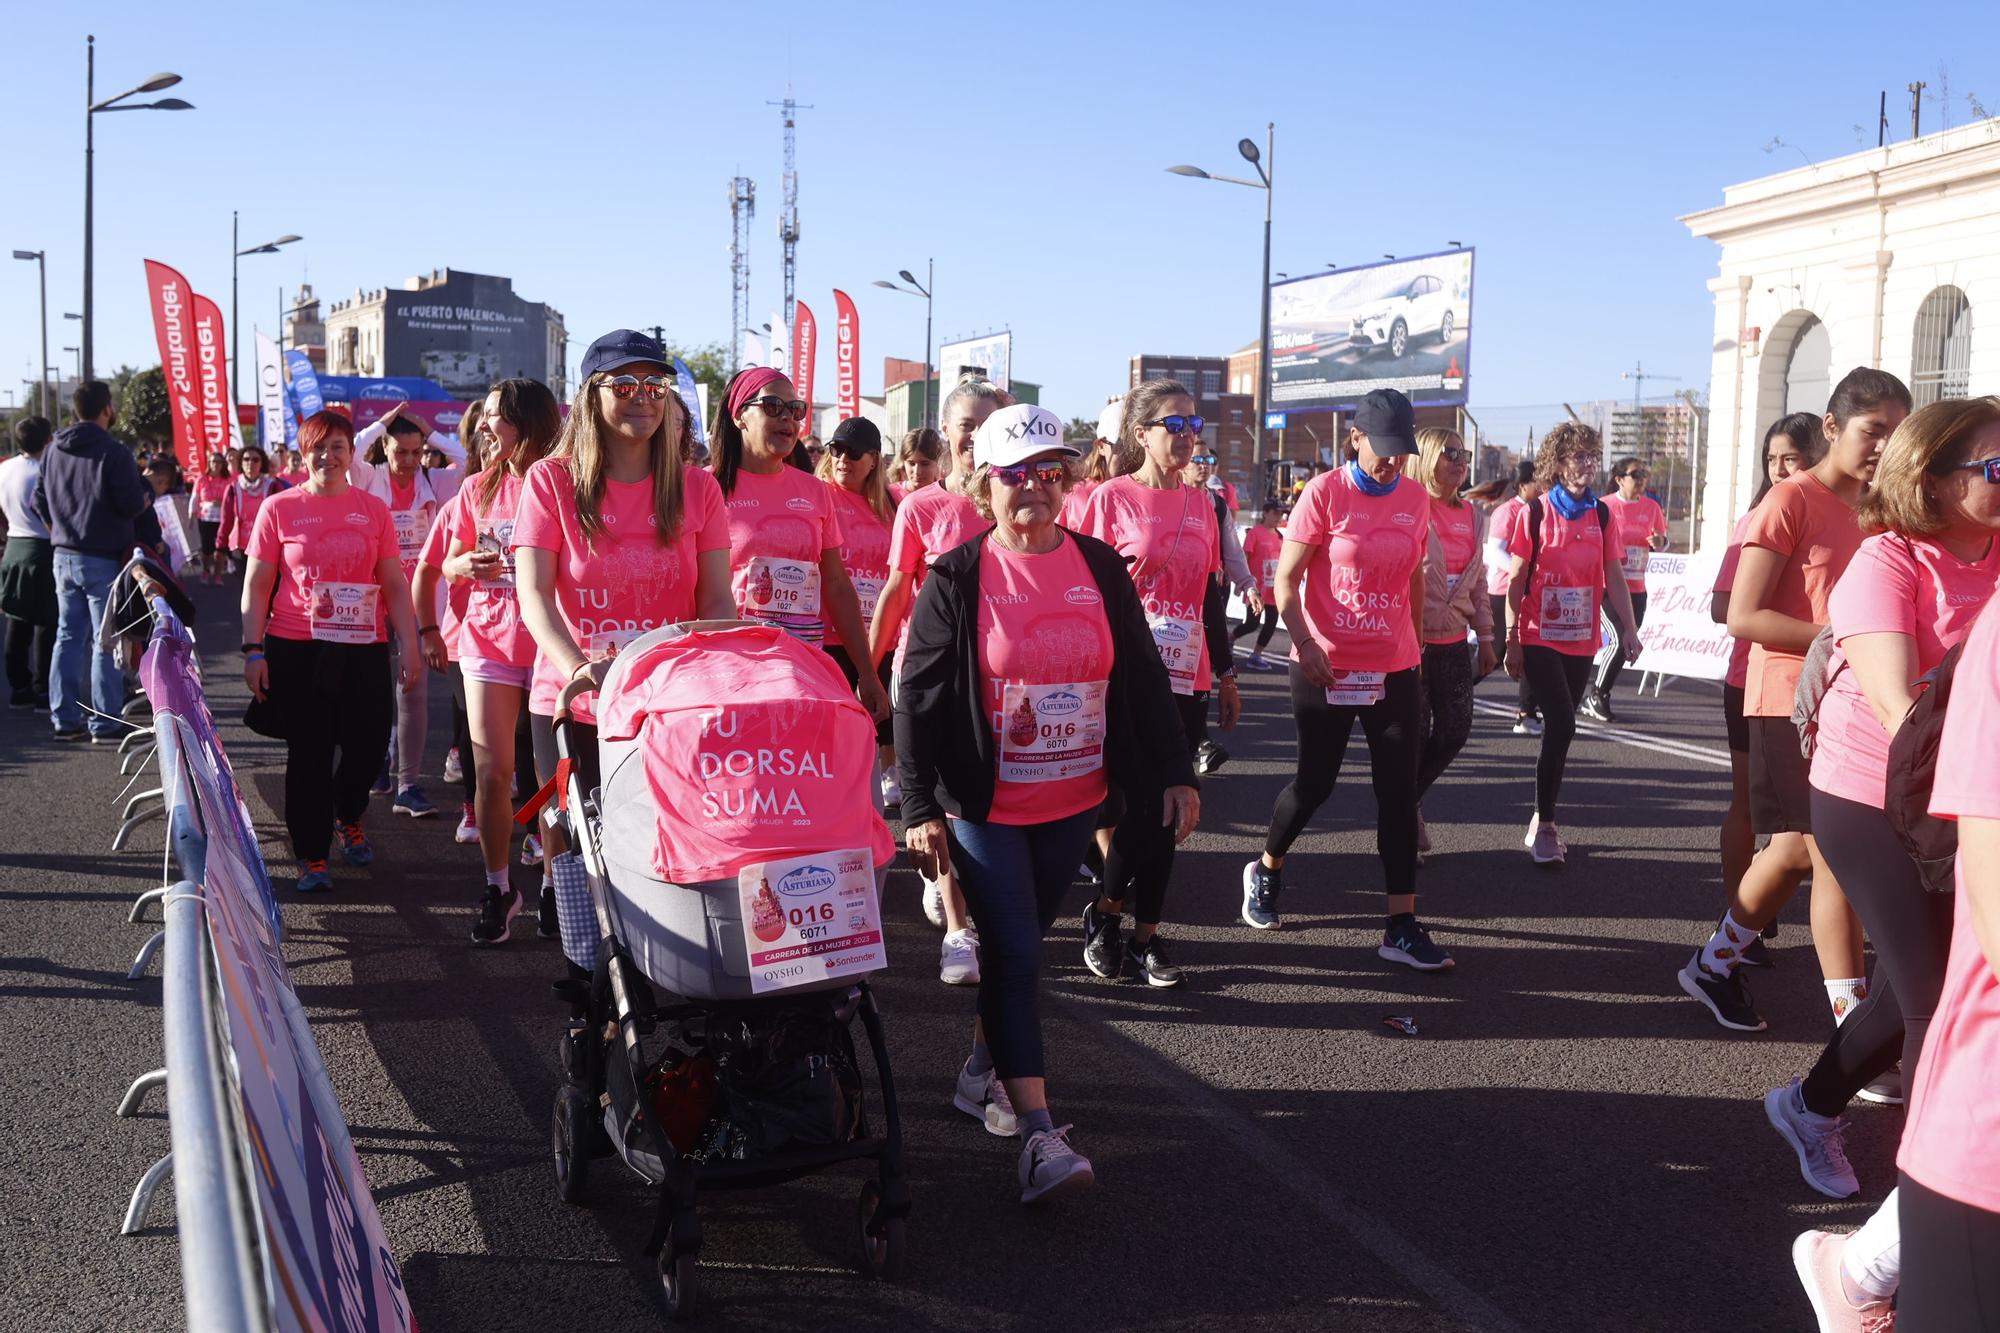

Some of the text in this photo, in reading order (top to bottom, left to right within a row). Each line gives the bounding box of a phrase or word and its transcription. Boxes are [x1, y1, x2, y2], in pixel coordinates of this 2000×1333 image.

[398, 307, 409, 317] EL
[412, 305, 453, 319] PUERTO
[1004, 414, 1057, 444] XXIO
[1340, 566, 1363, 584] TU
[1543, 573, 1561, 585] TU
[575, 588, 608, 609] TU
[774, 589, 798, 601] 016
[985, 593, 1029, 604] OYSHO
[336, 606, 360, 616] 016
[777, 602, 792, 610] 1027
[1334, 612, 1390, 631] SUMA
[1040, 701, 1079, 711] ASTURIANA
[698, 710, 738, 738] TU
[1041, 722, 1076, 737] 016
[1046, 739, 1068, 749] 6070
[700, 748, 834, 780] DORSAL
[1067, 761, 1096, 771] Santander
[1010, 768, 1044, 776] OYSHO
[702, 786, 807, 818] SUMA
[792, 818, 811, 826] 2023
[838, 864, 864, 875] SUMA
[783, 876, 832, 892] ASTURIANA
[789, 902, 835, 926] 016
[800, 925, 828, 939] 6071
[764, 936, 870, 961] CARRERA DE LA MUJER 2023
[835, 953, 876, 966] Santander
[763, 965, 804, 981] OYSHO
